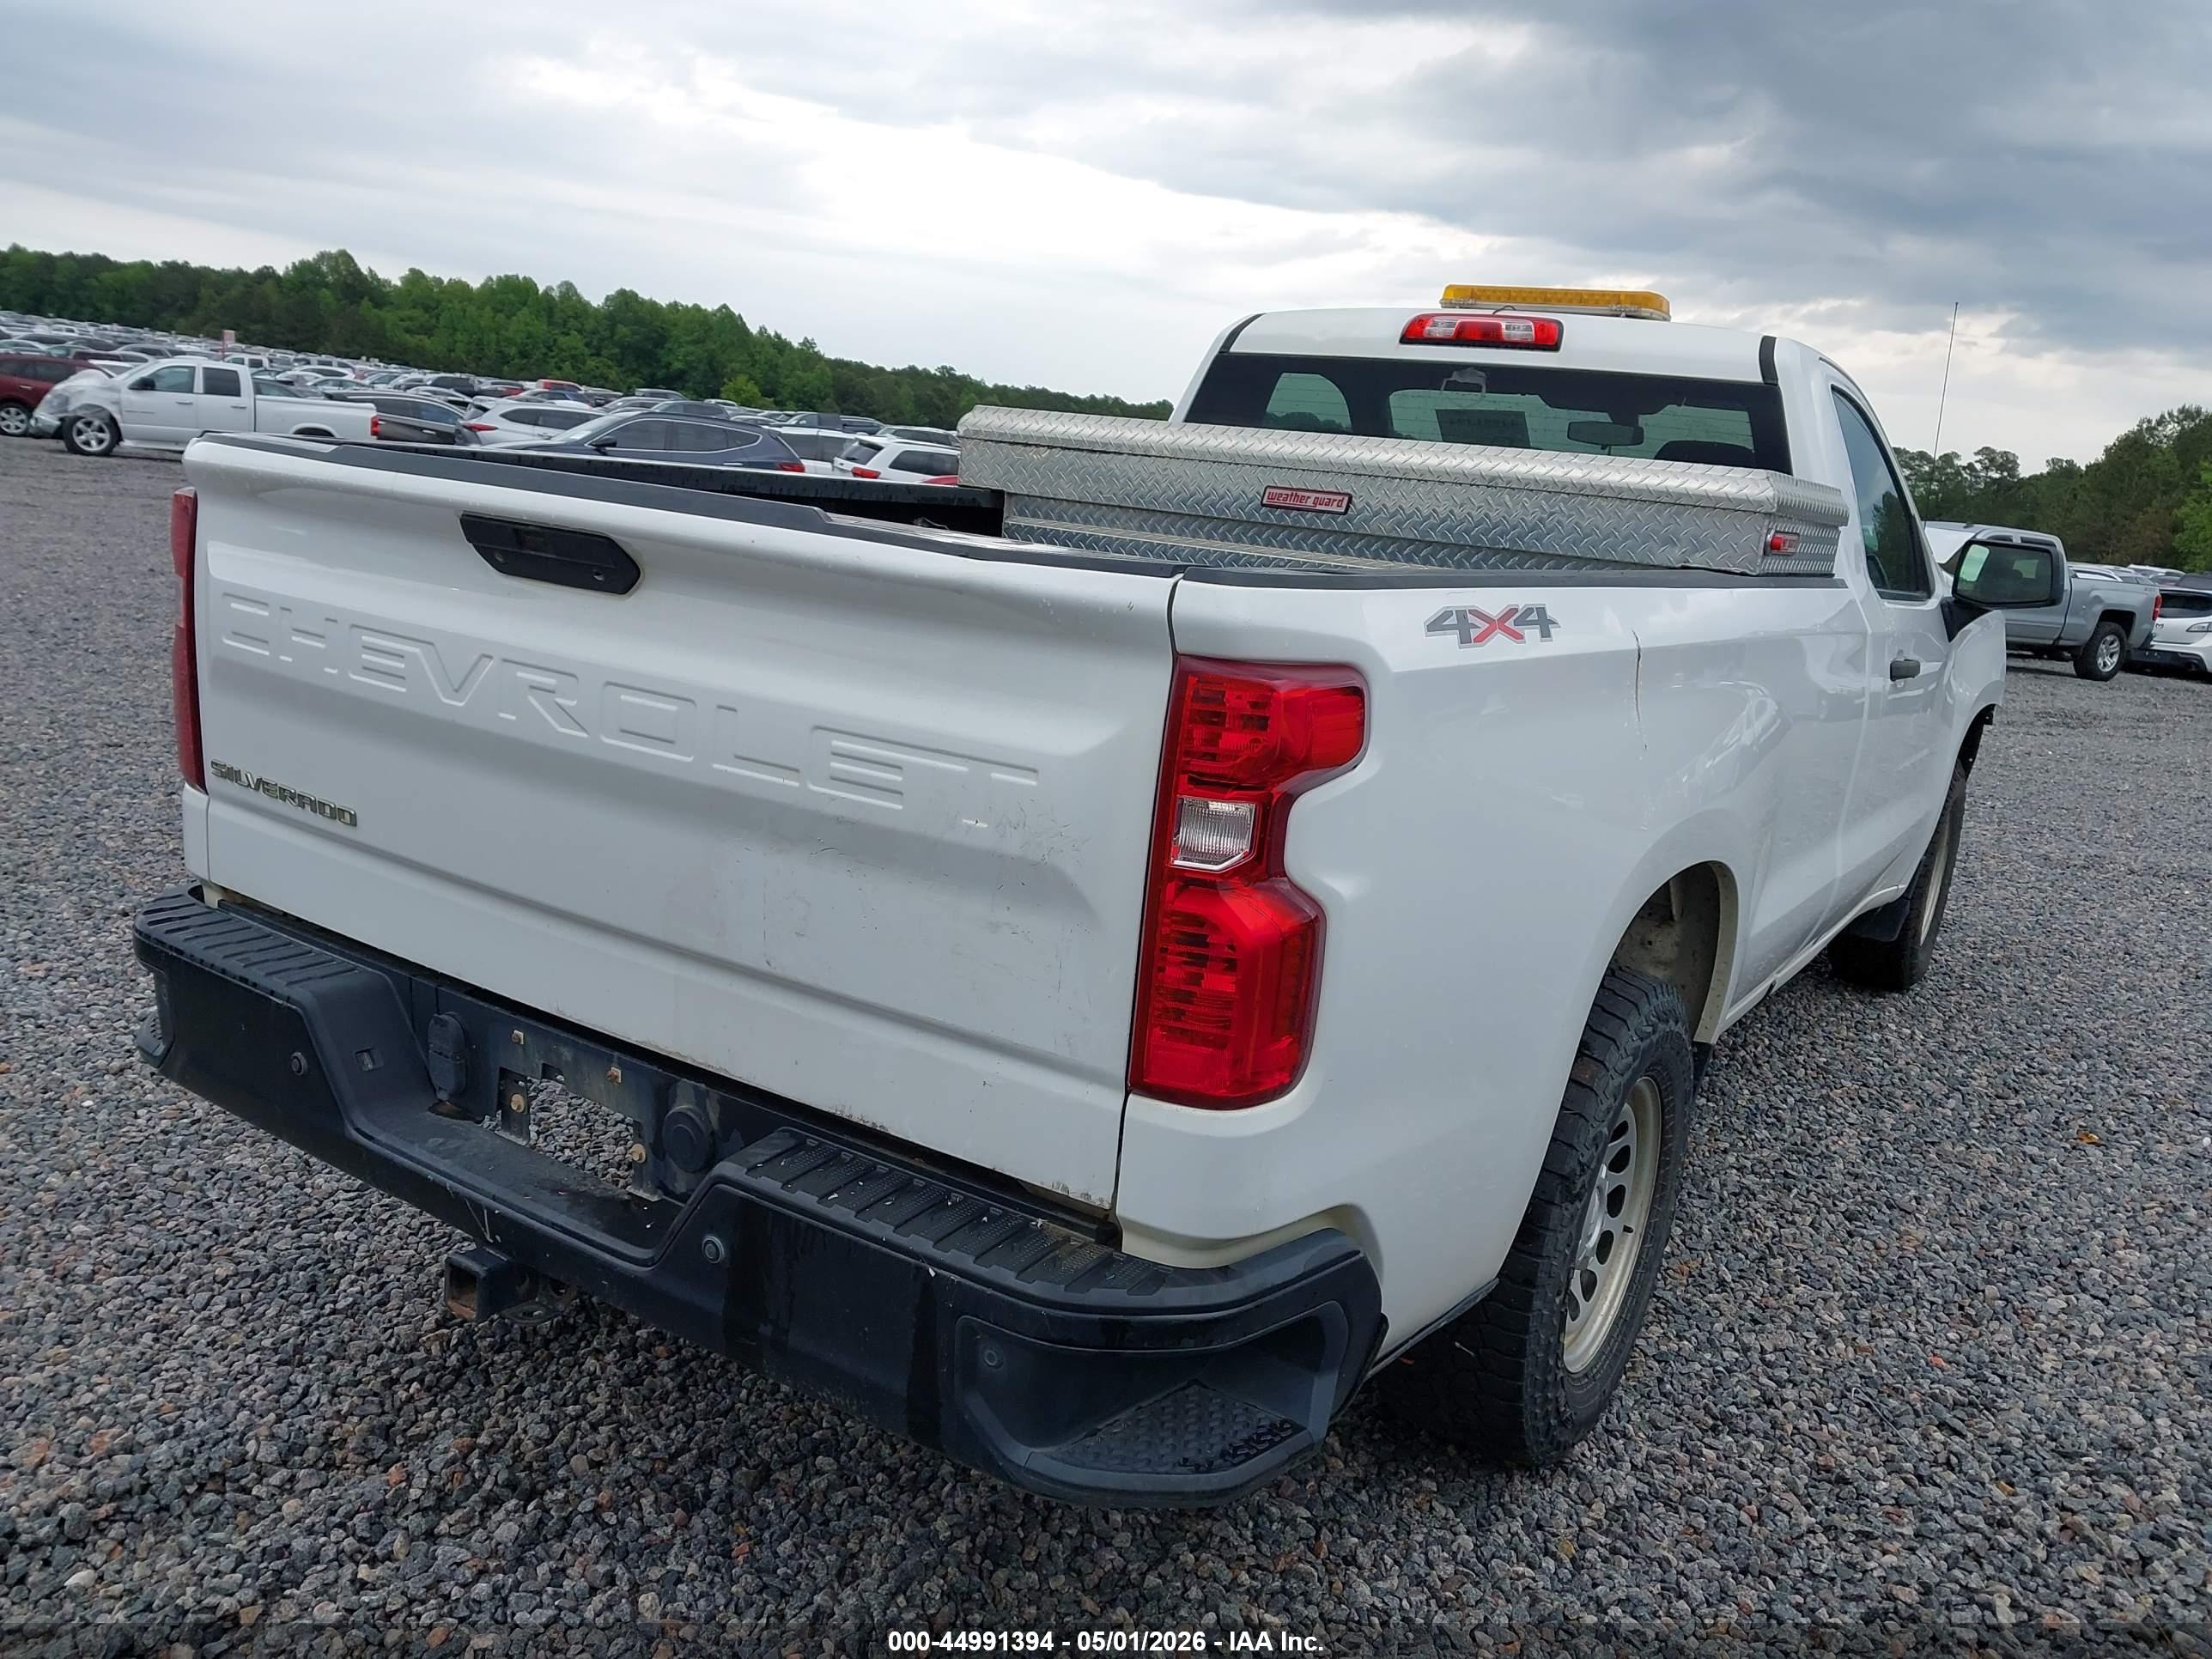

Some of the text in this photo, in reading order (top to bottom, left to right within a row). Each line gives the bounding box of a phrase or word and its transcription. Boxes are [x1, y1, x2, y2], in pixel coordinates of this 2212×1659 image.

[1267, 491, 1345, 508] weather guard
[221, 592, 1039, 828] CHEVROLET
[210, 758, 357, 827] SILVERADO
